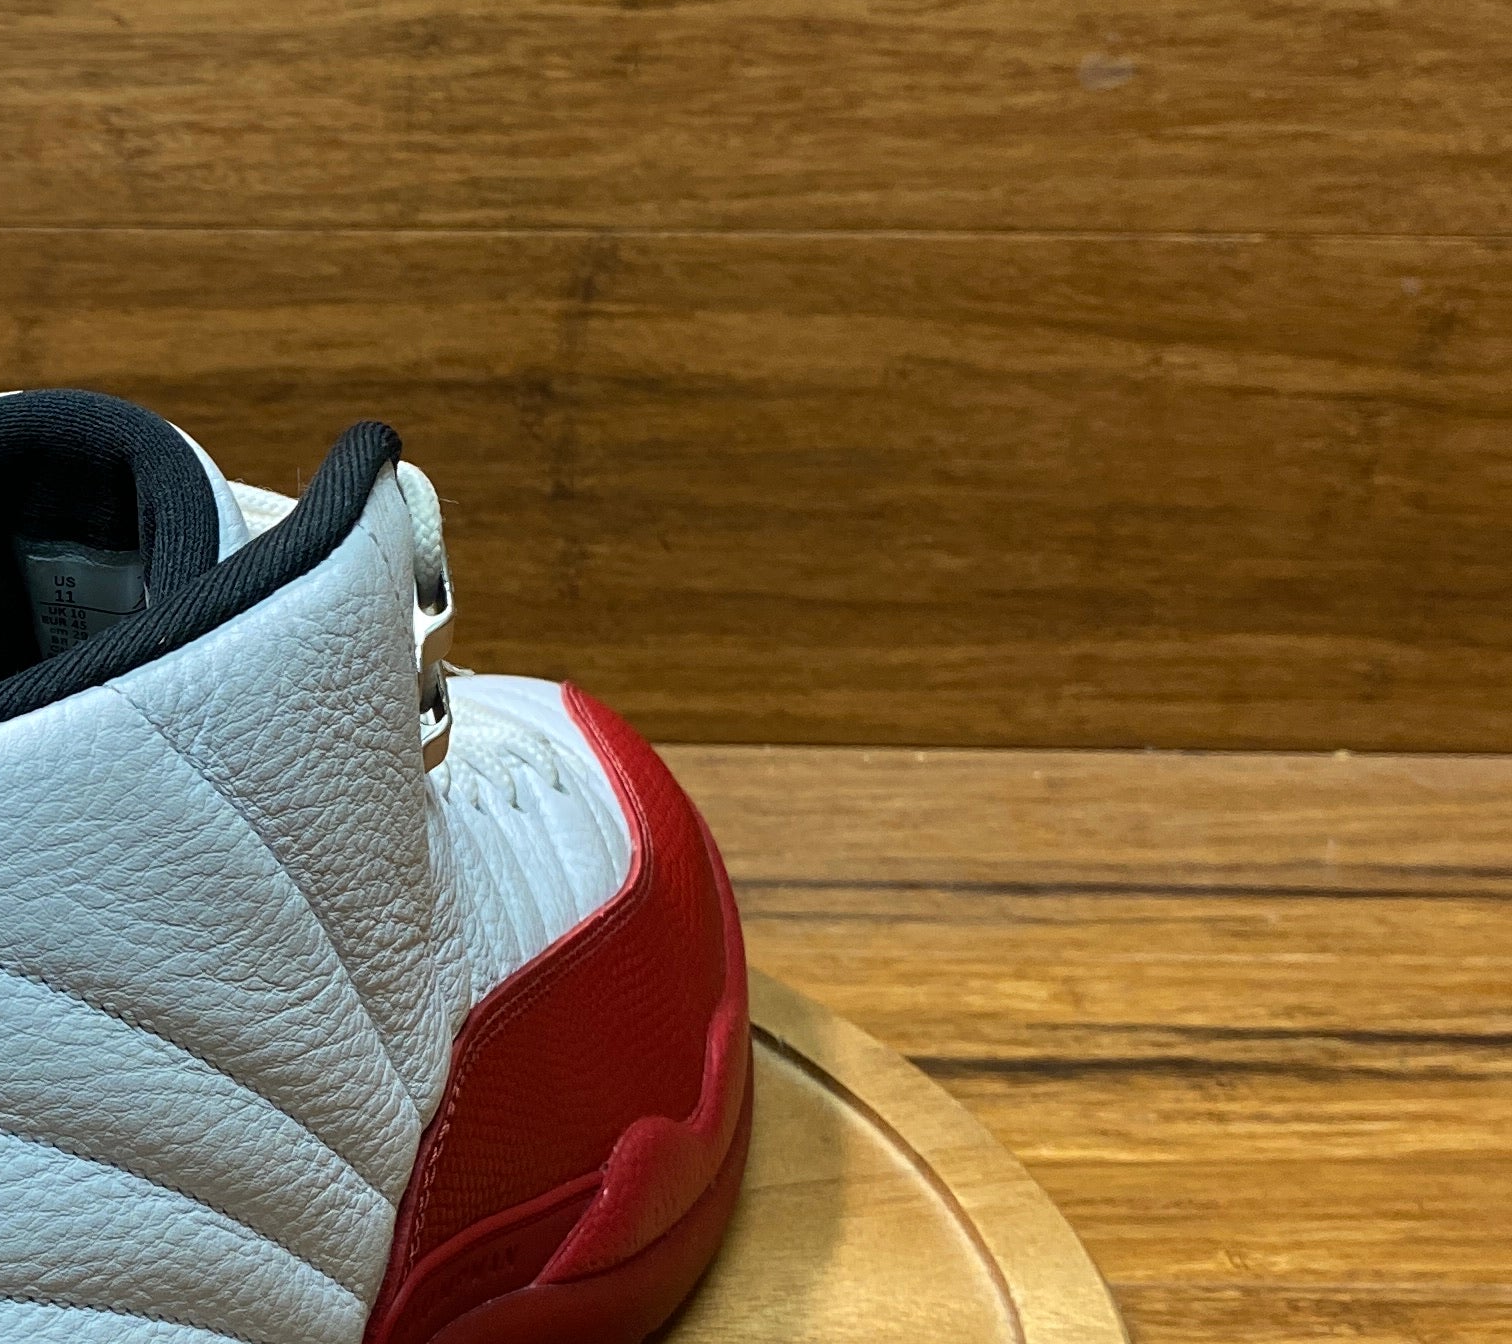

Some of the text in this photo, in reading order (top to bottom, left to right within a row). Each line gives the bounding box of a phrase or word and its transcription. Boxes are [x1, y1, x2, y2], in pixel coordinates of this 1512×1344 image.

[54, 575, 76, 588] US
[54, 589, 76, 603] 11
[48, 606, 86, 620] UK 10
[41, 614, 87, 630] EUR 45
